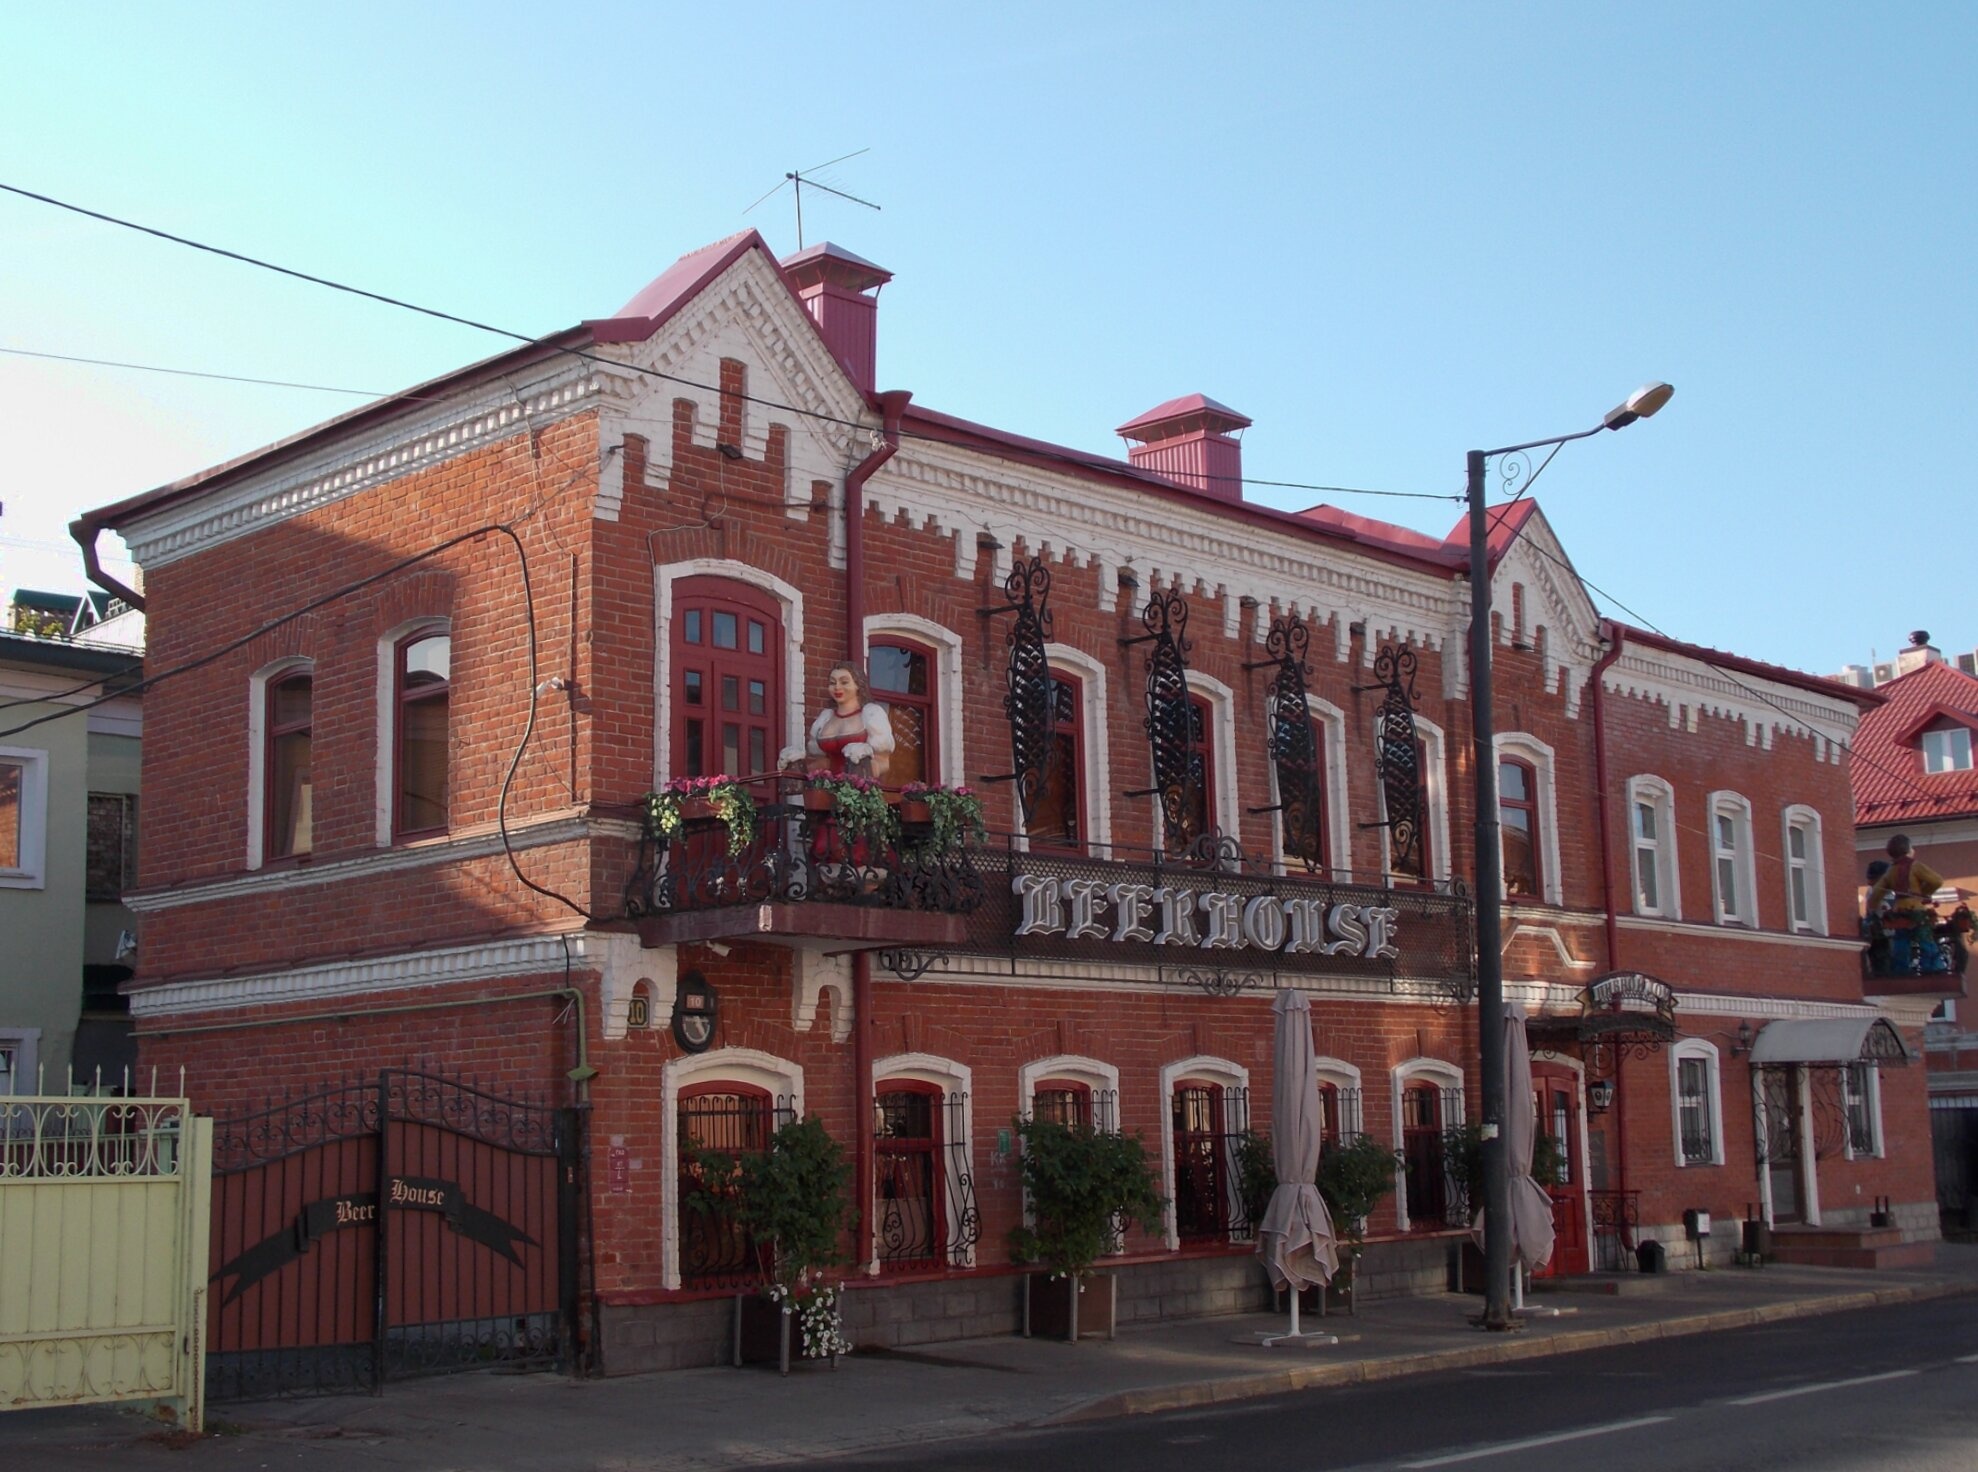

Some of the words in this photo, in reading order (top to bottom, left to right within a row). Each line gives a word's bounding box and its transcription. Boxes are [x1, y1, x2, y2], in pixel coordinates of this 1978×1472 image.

[1012, 874, 1400, 959] BEERHOUSE
[629, 1001, 645, 1024] 10
[690, 998, 702, 1006] 10
[336, 1200, 376, 1225] Beer
[389, 1179, 445, 1205] House
